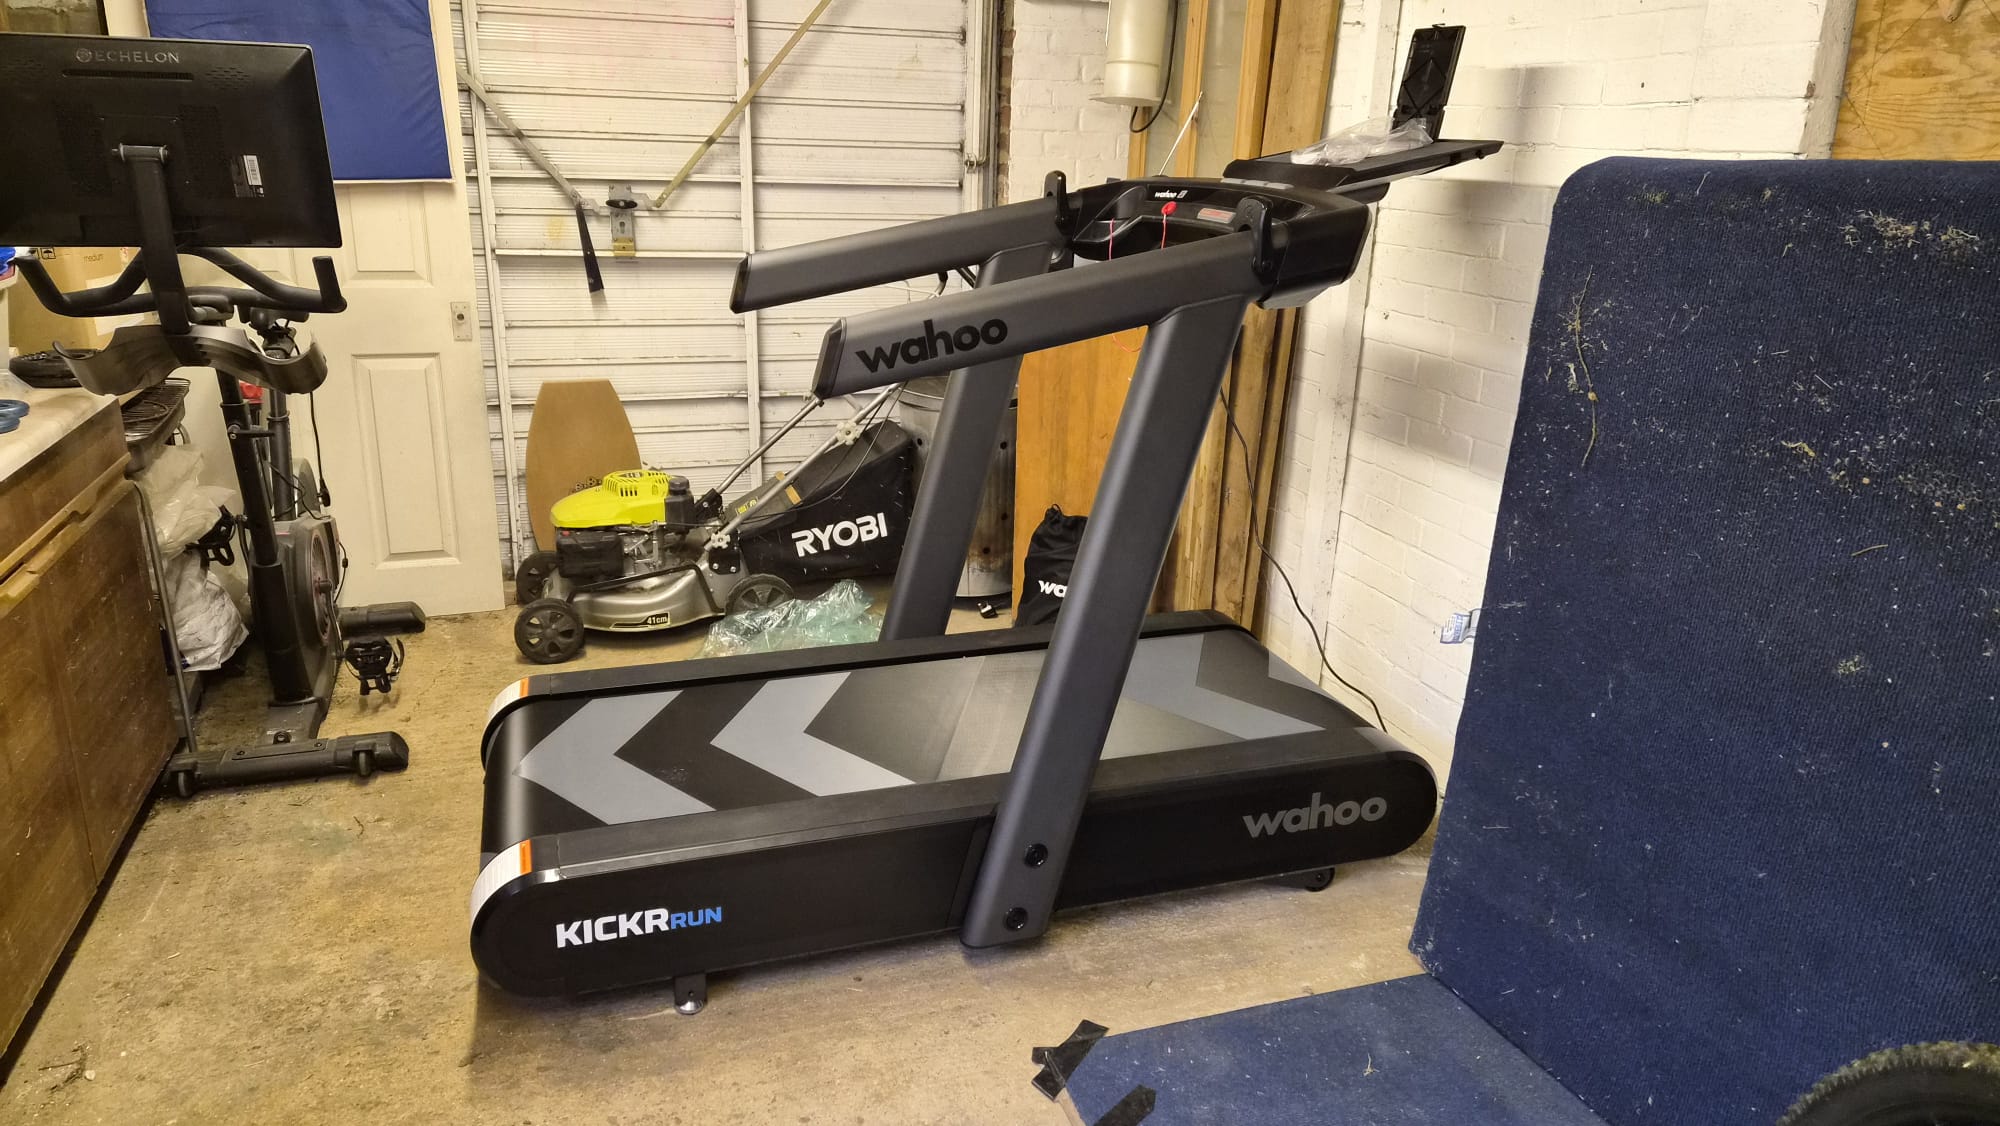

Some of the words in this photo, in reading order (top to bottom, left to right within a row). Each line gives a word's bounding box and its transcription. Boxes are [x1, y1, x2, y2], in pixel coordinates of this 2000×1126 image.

[95, 50, 180, 63] ECHELON
[855, 319, 1008, 374] wahoo
[791, 512, 888, 557] RYOBI
[647, 616, 668, 625] 41cm
[1242, 792, 1387, 838] wahoo
